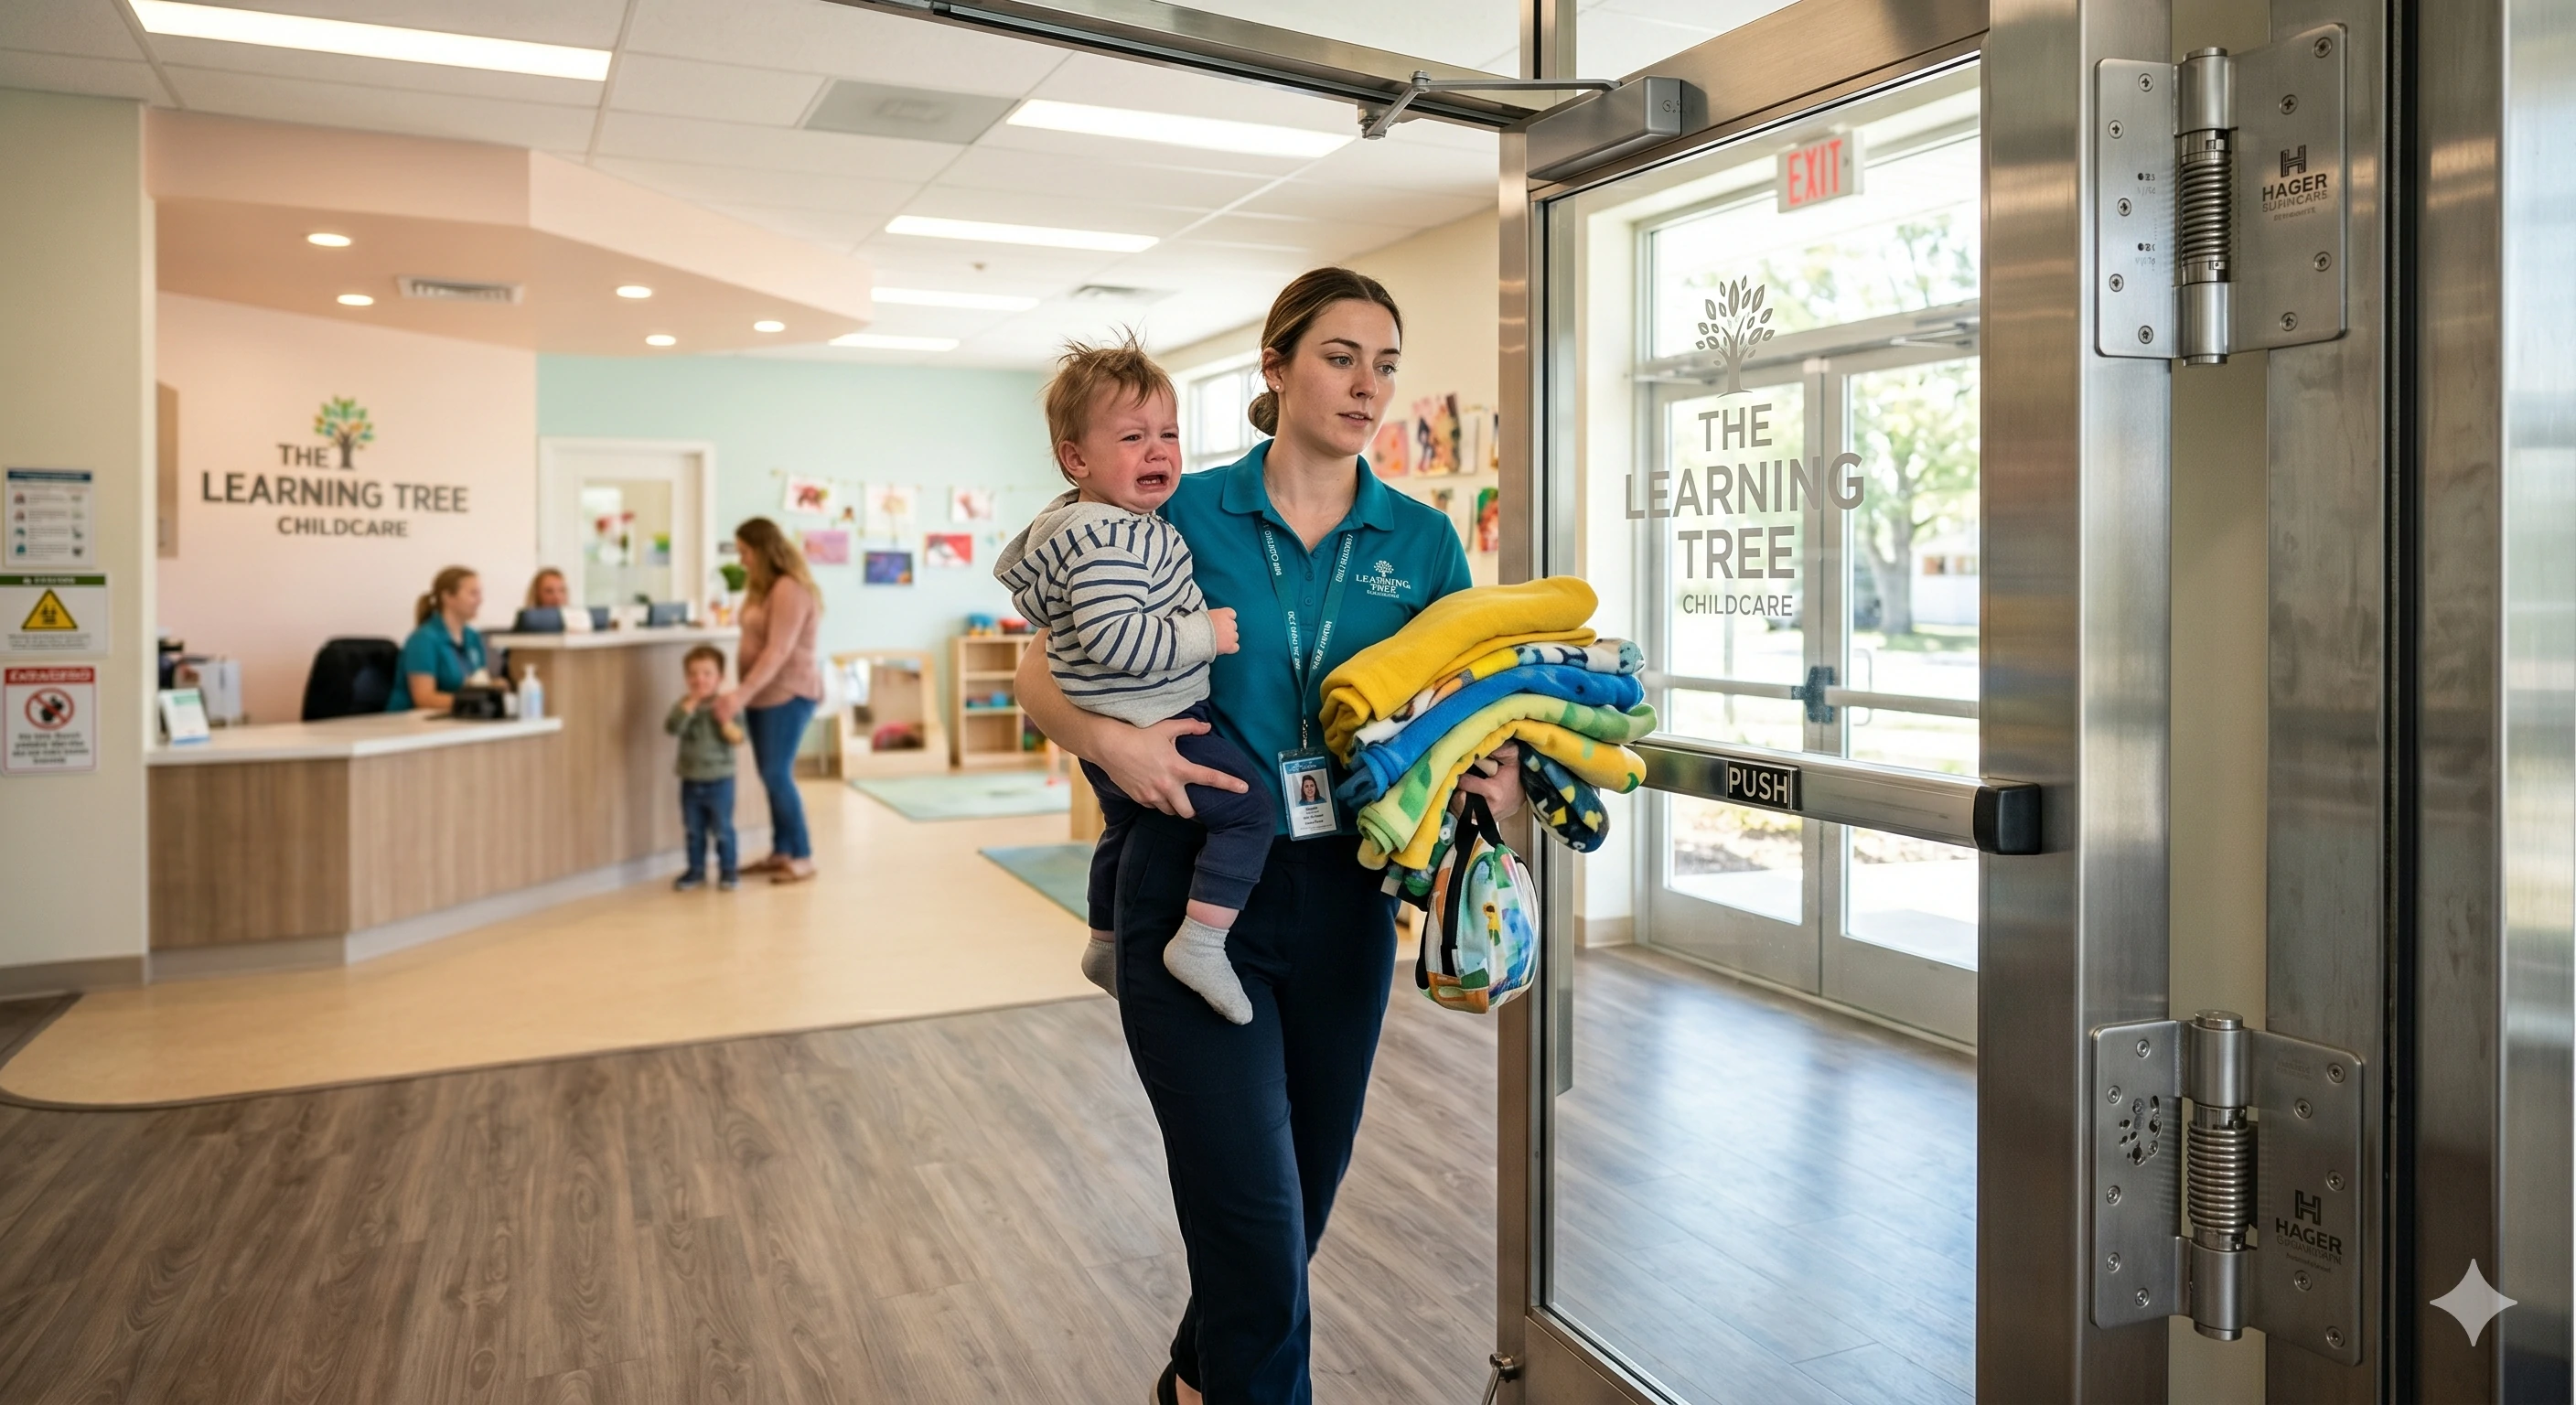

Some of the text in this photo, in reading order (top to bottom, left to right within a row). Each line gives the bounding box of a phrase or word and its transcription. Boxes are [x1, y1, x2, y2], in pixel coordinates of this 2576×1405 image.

[1787, 139, 1842, 206] EXIT
[2262, 174, 2327, 202] HAGER
[1699, 403, 1772, 451] THE
[277, 443, 329, 469] THE
[201, 471, 469, 514] LEARNING TREE
[1626, 453, 1864, 520] LEARNING
[276, 516, 408, 538] CHILDCARE
[1678, 526, 1795, 578] TREE
[1682, 595, 1793, 617] CHILDCARE
[1729, 767, 1787, 804] PUSH
[2276, 1217, 2342, 1255] HAGER
